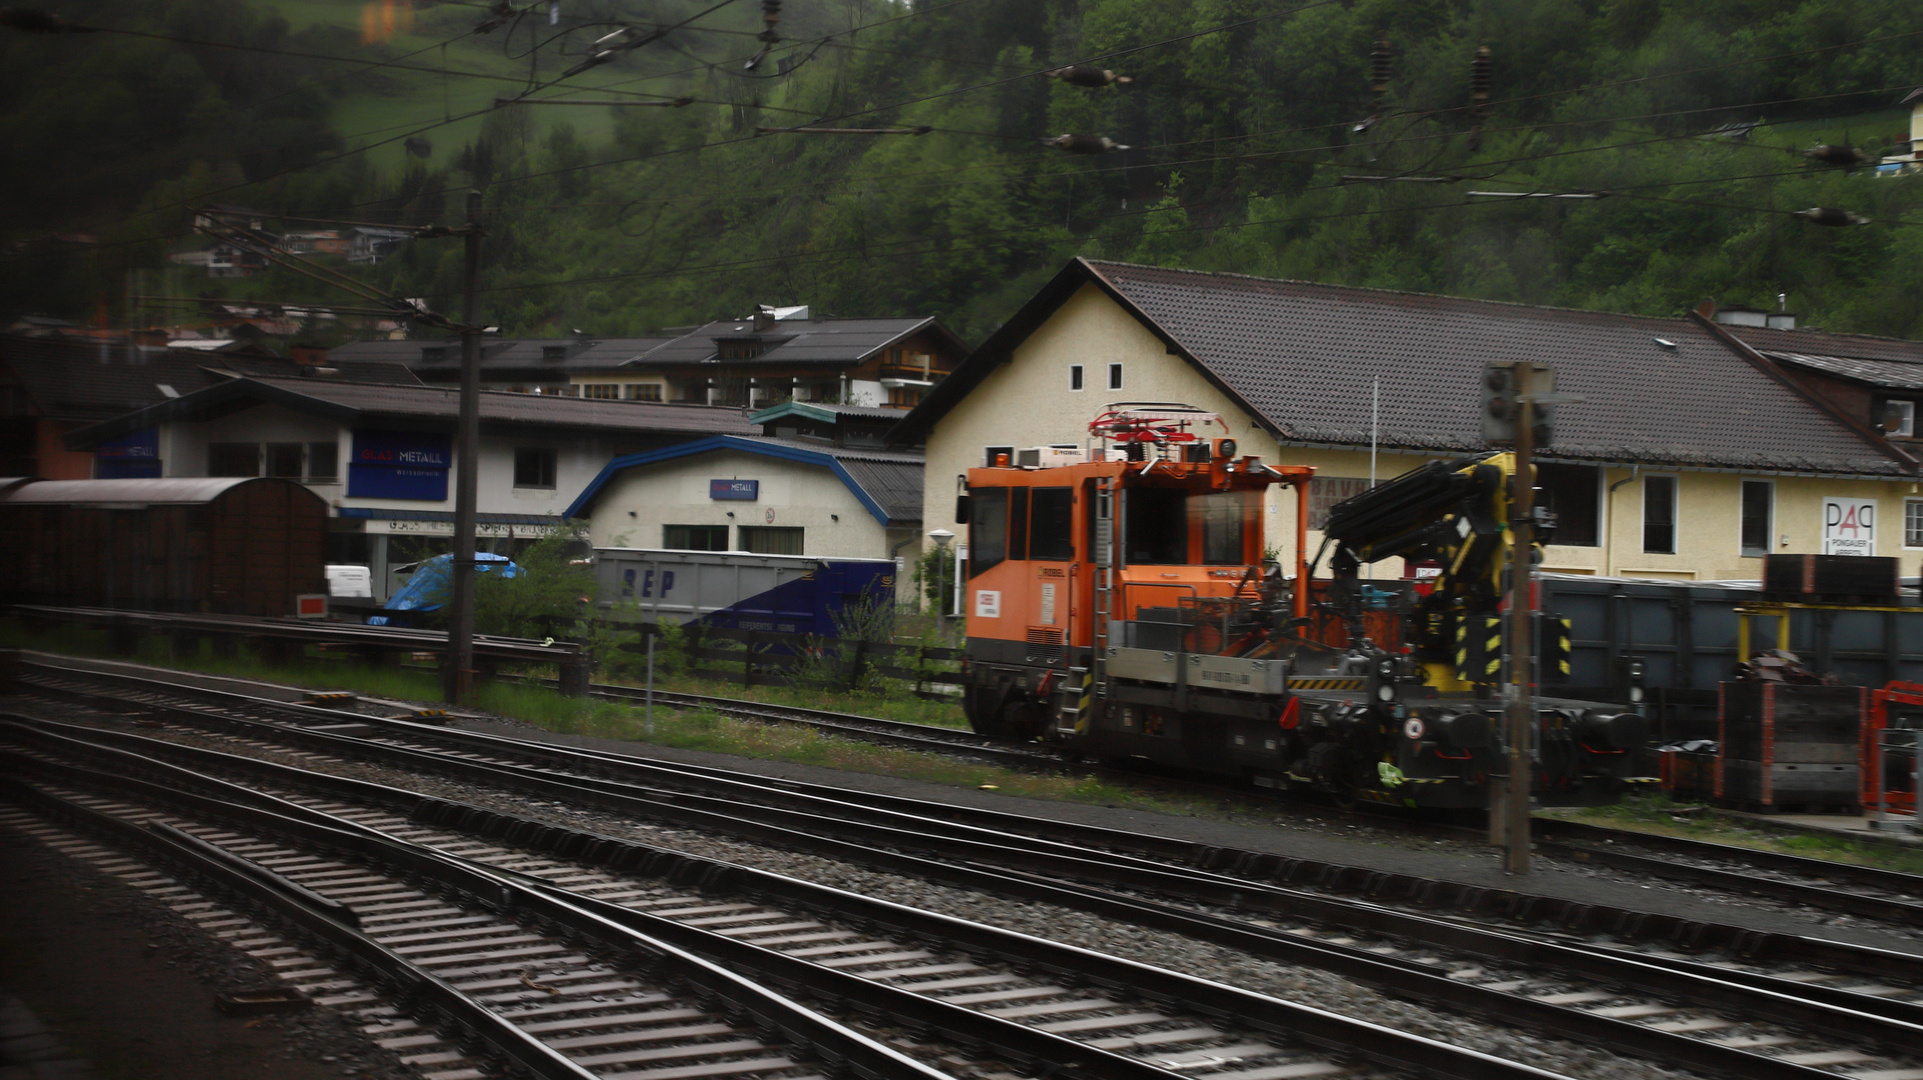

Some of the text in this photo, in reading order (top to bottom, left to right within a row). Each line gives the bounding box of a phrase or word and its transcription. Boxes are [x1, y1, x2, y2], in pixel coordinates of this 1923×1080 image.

[361, 449, 443, 464] GLAS METALL
[731, 483, 752, 492] METALL
[1832, 538, 1867, 548] PONGAUER
[1043, 568, 1066, 578] ROBEL
